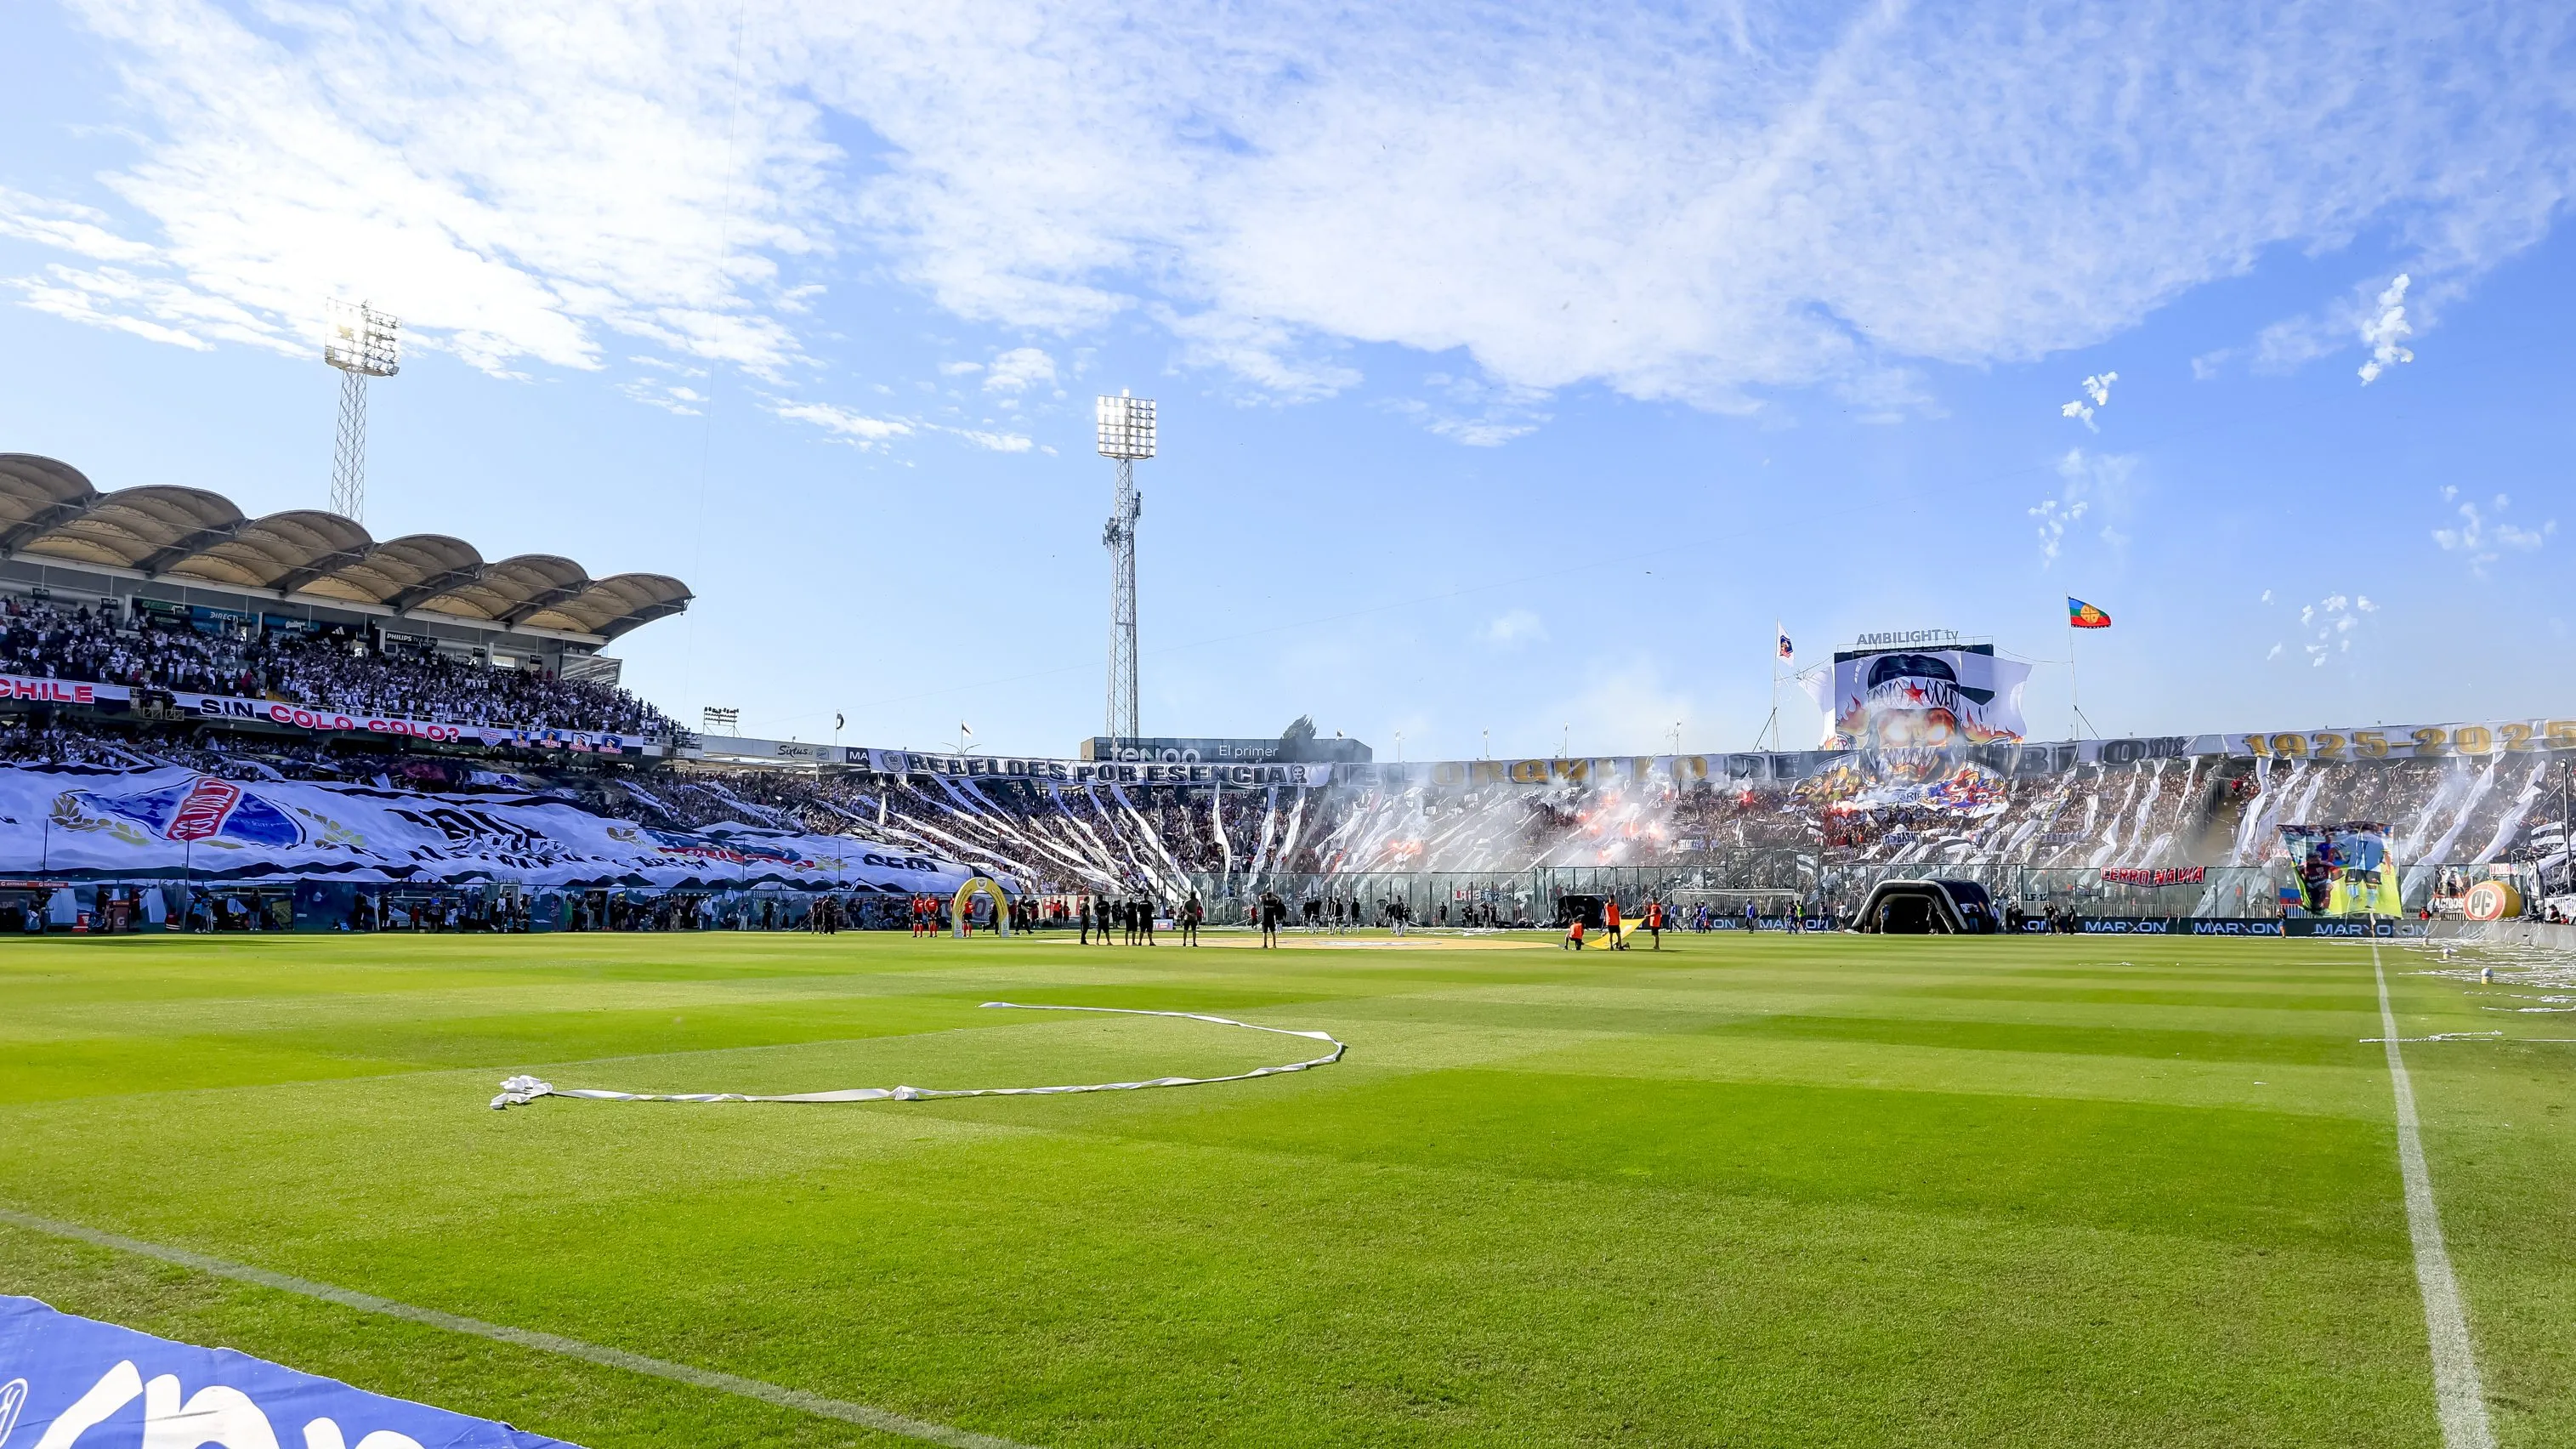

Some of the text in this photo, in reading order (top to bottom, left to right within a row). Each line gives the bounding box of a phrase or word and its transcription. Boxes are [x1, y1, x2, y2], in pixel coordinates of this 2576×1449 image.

[387, 633, 412, 642] PHILIPS
[1857, 629, 1941, 645] AMBILIGHT
[201, 699, 255, 717] SIN
[270, 705, 460, 742] COLO COLO?
[2245, 721, 2576, 758] 1925-2025
[1219, 745, 1279, 759] El primer
[905, 753, 1289, 786] REBELDES POR ESENCIA
[2101, 867, 2204, 884] CERRO NAVIA
